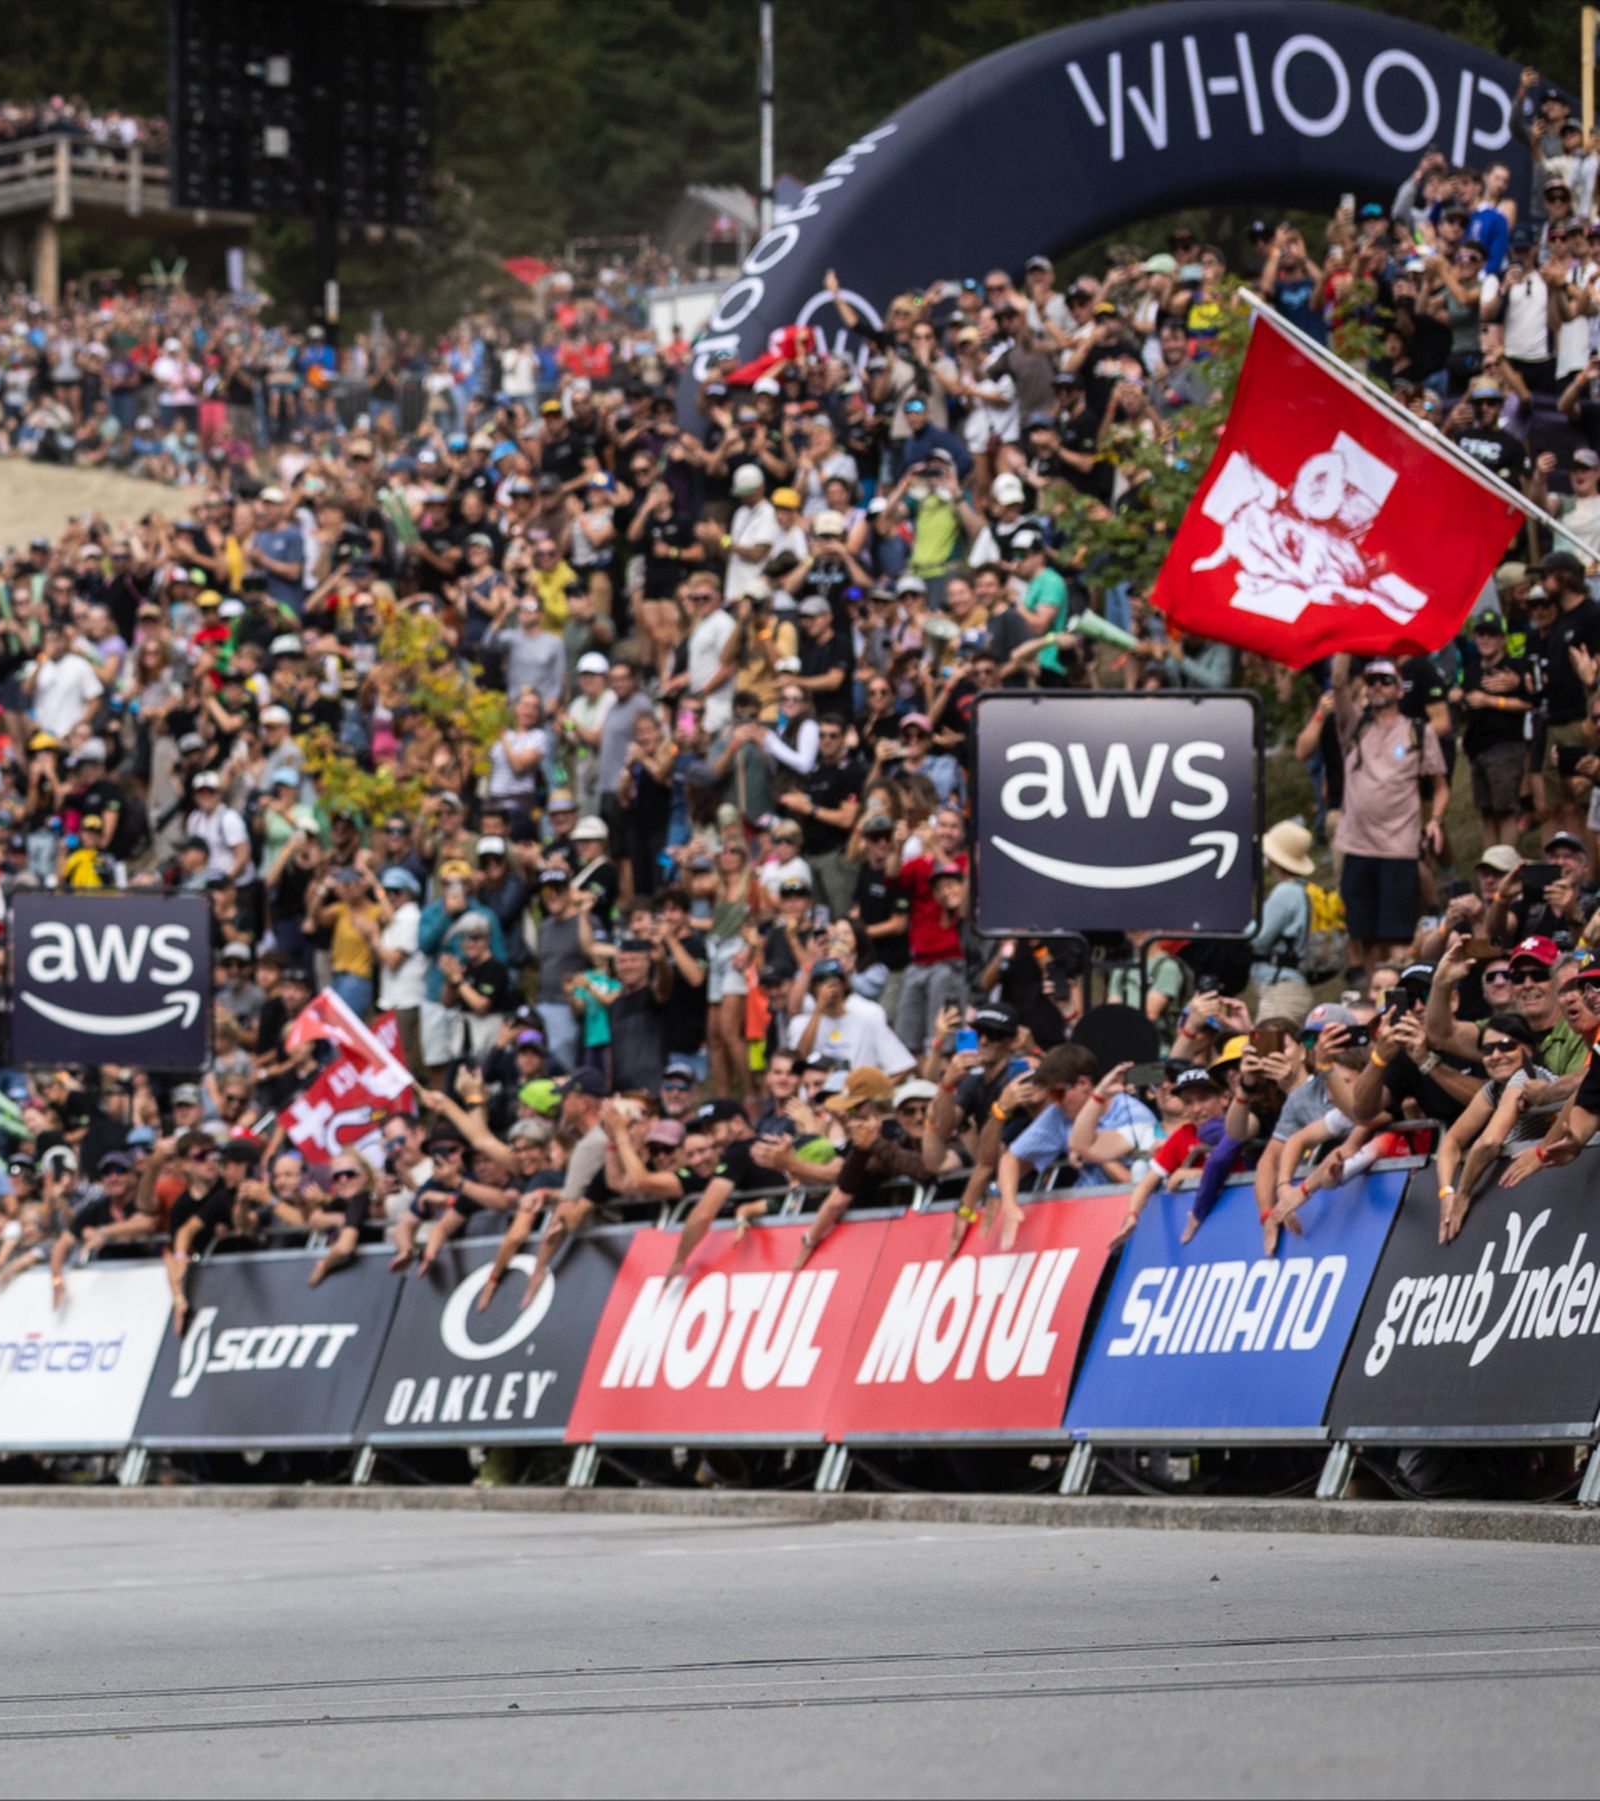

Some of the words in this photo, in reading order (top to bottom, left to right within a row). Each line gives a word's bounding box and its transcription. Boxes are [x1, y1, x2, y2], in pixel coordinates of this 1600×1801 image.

[1066, 32, 1514, 169] WHOOP
[1000, 741, 1229, 821] aws
[26, 921, 194, 985] aws
[206, 1323, 359, 1373] SCOTT
[601, 1269, 839, 1391] MOTUL
[855, 1248, 1080, 1385] MOTUL
[1107, 1255, 1348, 1357] SHIMANO
[384, 1371, 553, 1426] OAKLEY
